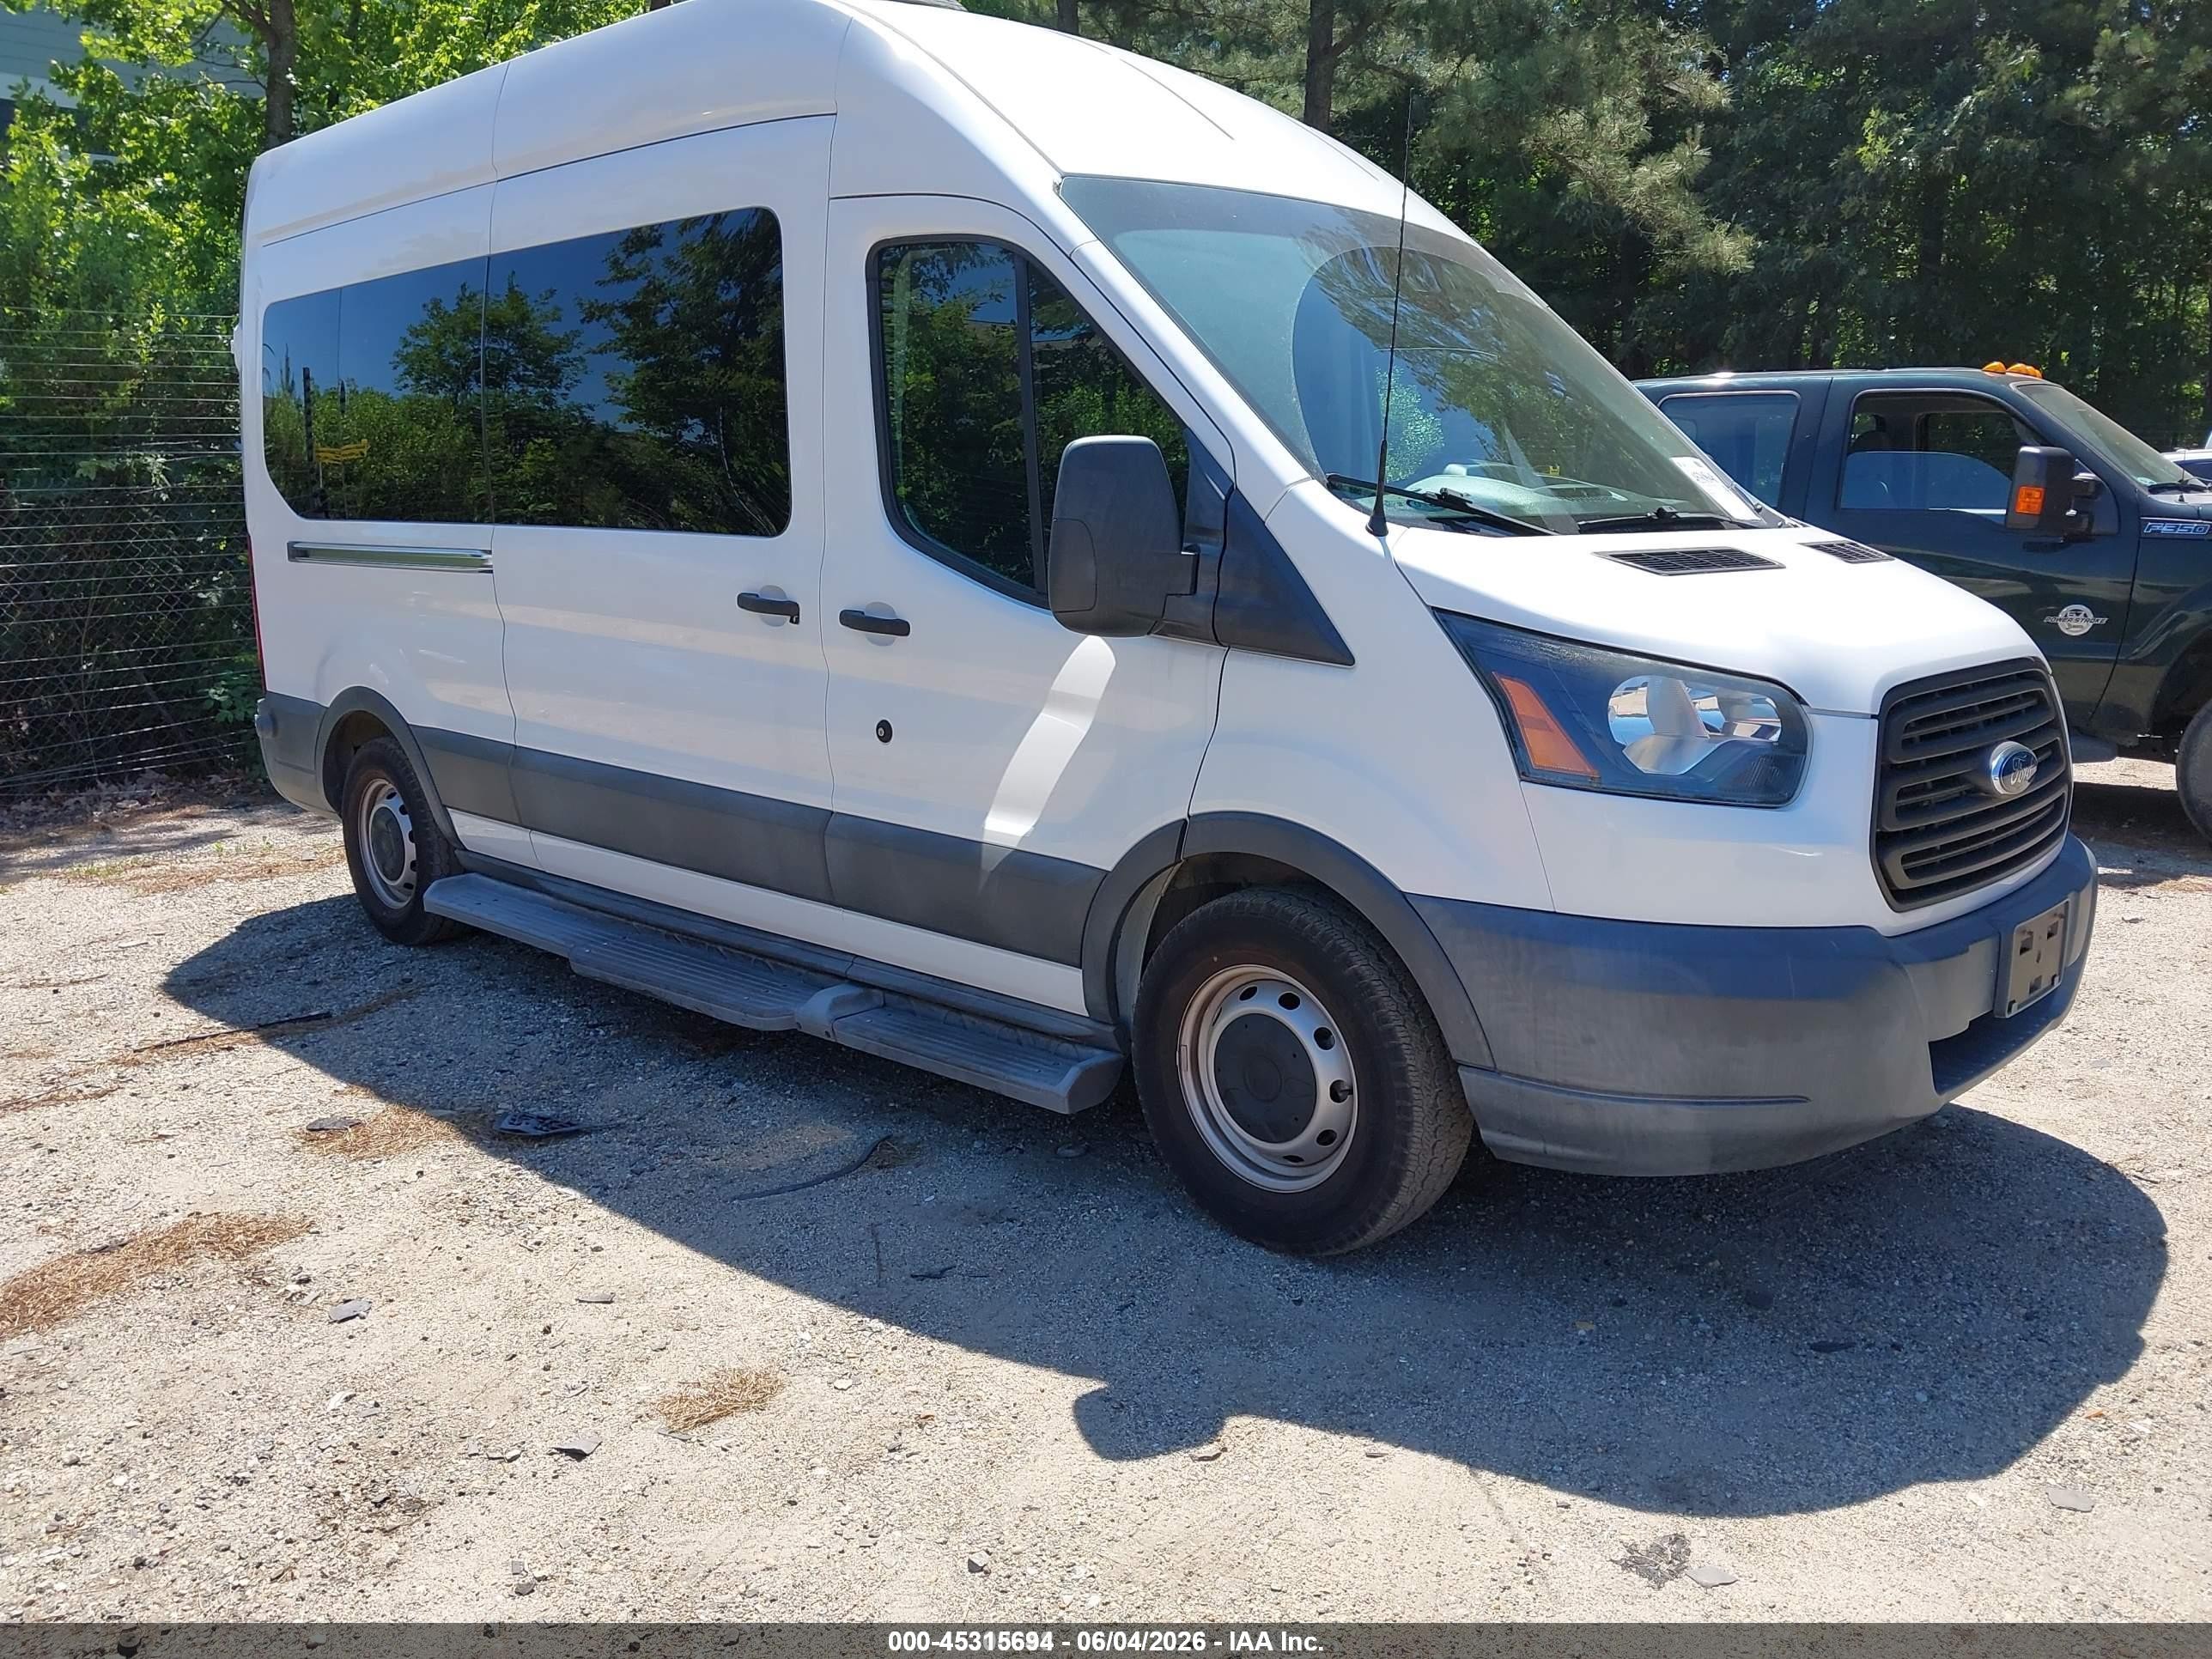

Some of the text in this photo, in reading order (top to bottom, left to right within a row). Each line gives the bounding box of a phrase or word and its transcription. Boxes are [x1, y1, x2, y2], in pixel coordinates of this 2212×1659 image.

[2143, 521, 2210, 535] F-350
[2045, 616, 2108, 625] POWER STROKE
[2010, 754, 2037, 786] Ford
